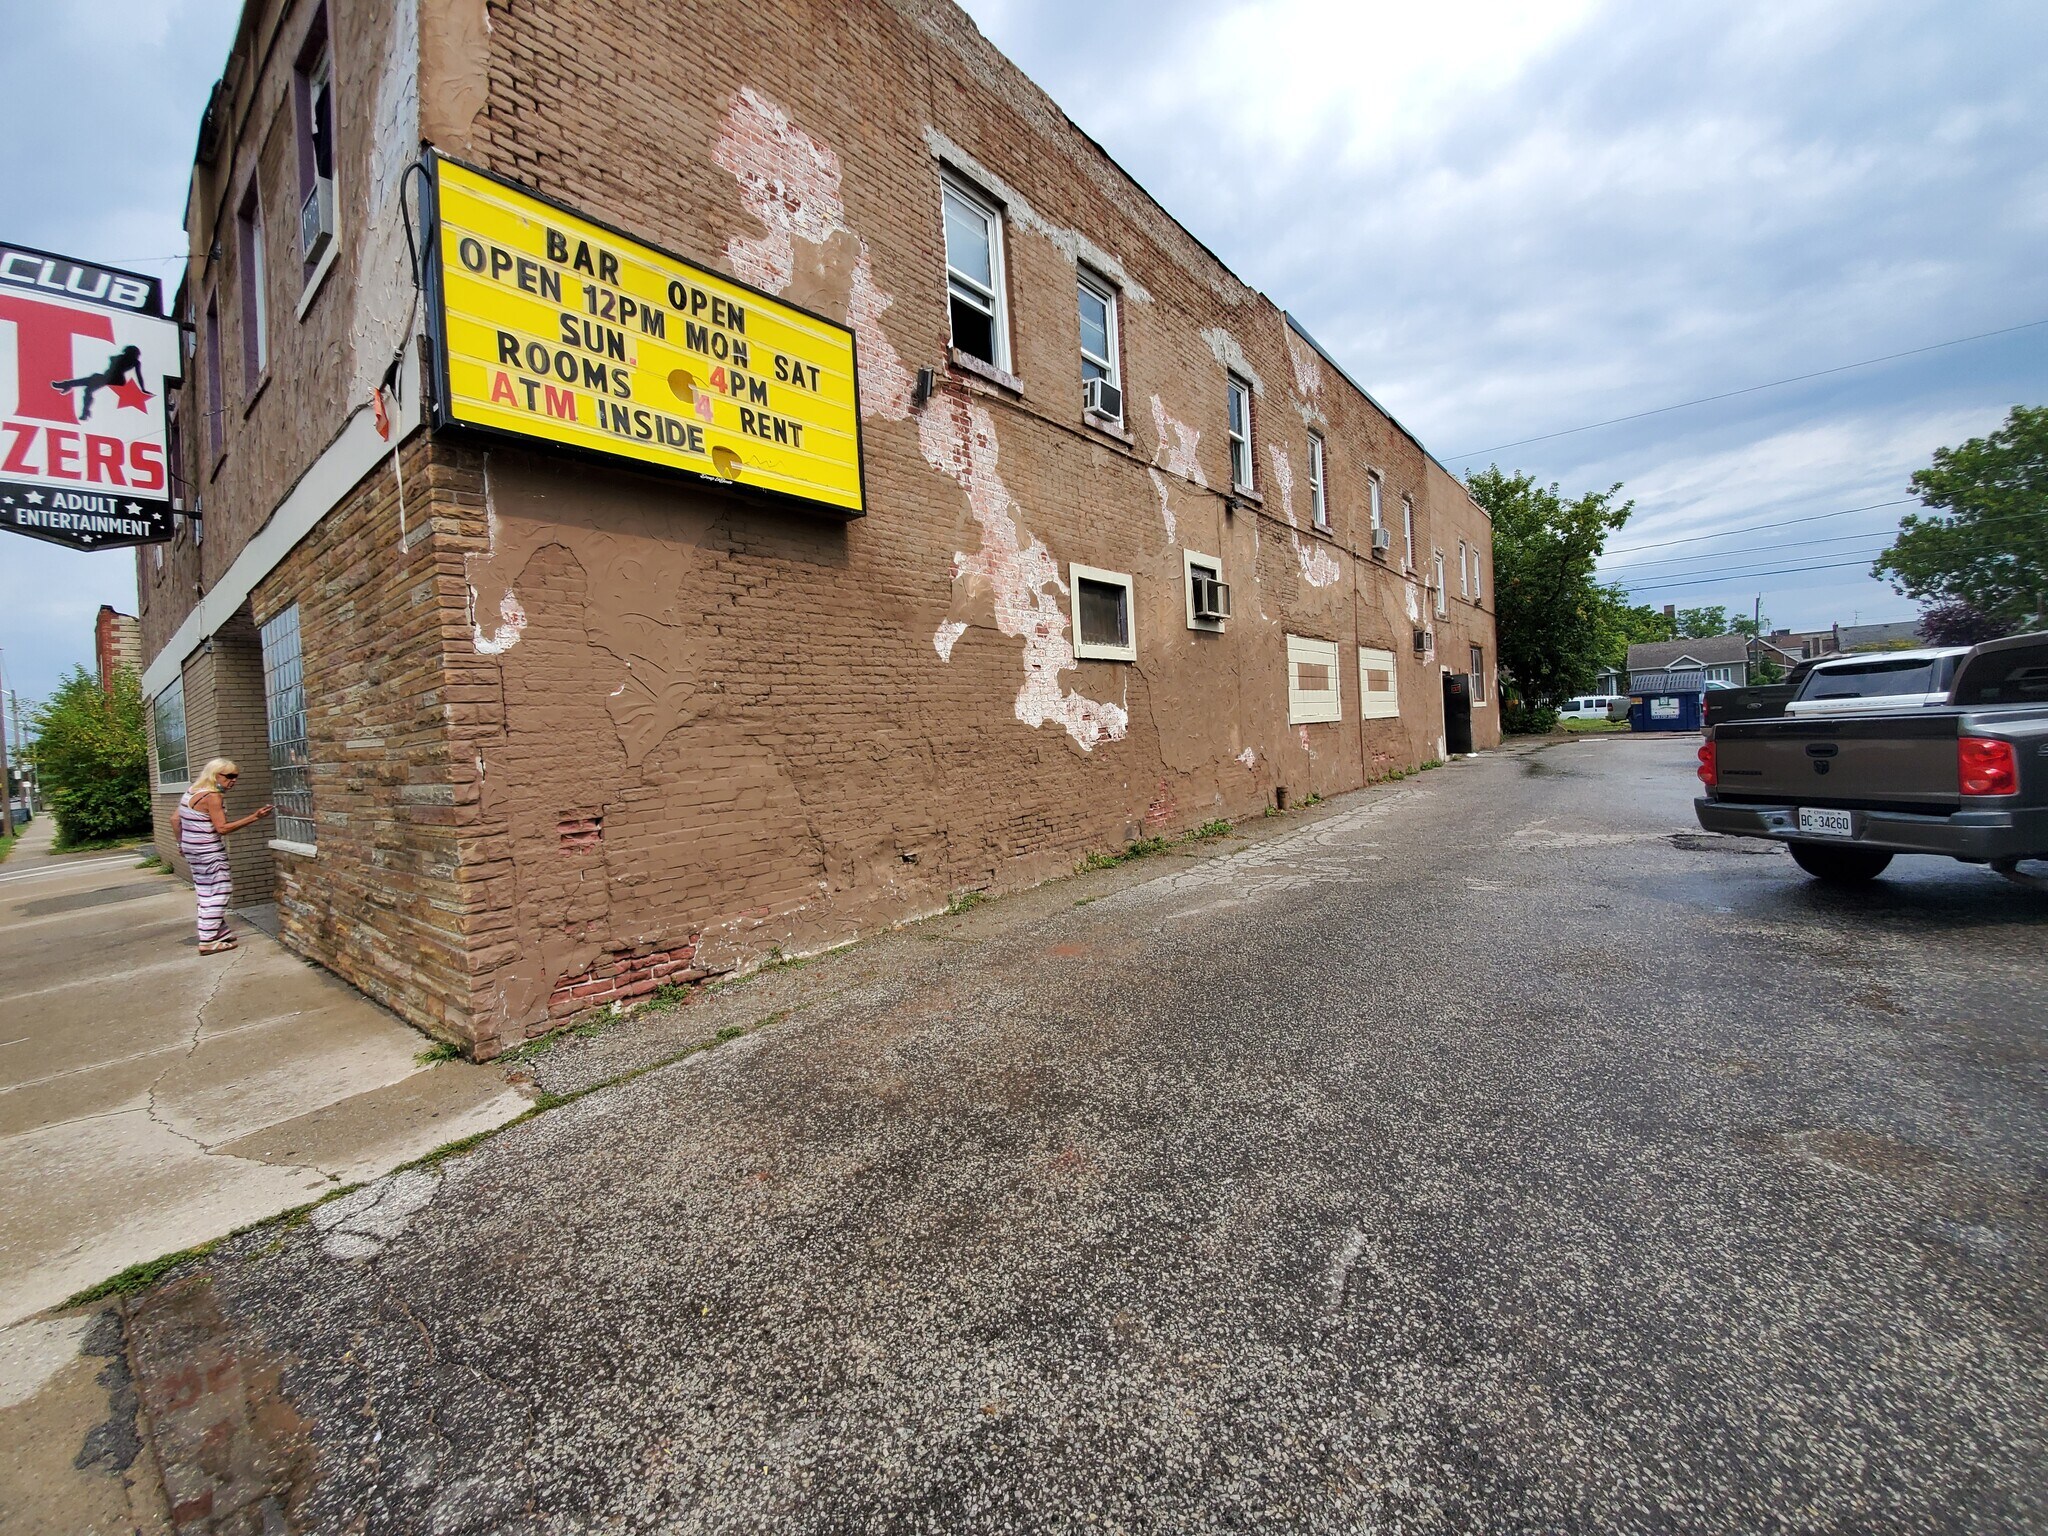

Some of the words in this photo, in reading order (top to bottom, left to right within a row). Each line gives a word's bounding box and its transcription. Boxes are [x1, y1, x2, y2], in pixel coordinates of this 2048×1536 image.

[0, 252, 150, 309] CLUB
[459, 237, 562, 303] OPEN
[582, 284, 666, 340] 12PM
[685, 320, 749, 368] MON
[774, 354, 821, 392] SAT
[546, 227, 619, 286] BAR
[667, 280, 745, 335] OPEN
[497, 330, 632, 399] ROOMS
[693, 394, 714, 423] 4
[740, 406, 803, 448] RENT
[559, 312, 637, 366] SUN.
[709, 365, 768, 407] 4PM
[490, 371, 577, 422] ATM
[598, 398, 706, 454] INSIDE
[1, 420, 165, 491] ZERS
[16, 507, 152, 538] ENTERTAINMENT
[52, 491, 119, 516] ADULT
[1800, 814, 1813, 827] BC
[1818, 815, 1849, 830] 34260
